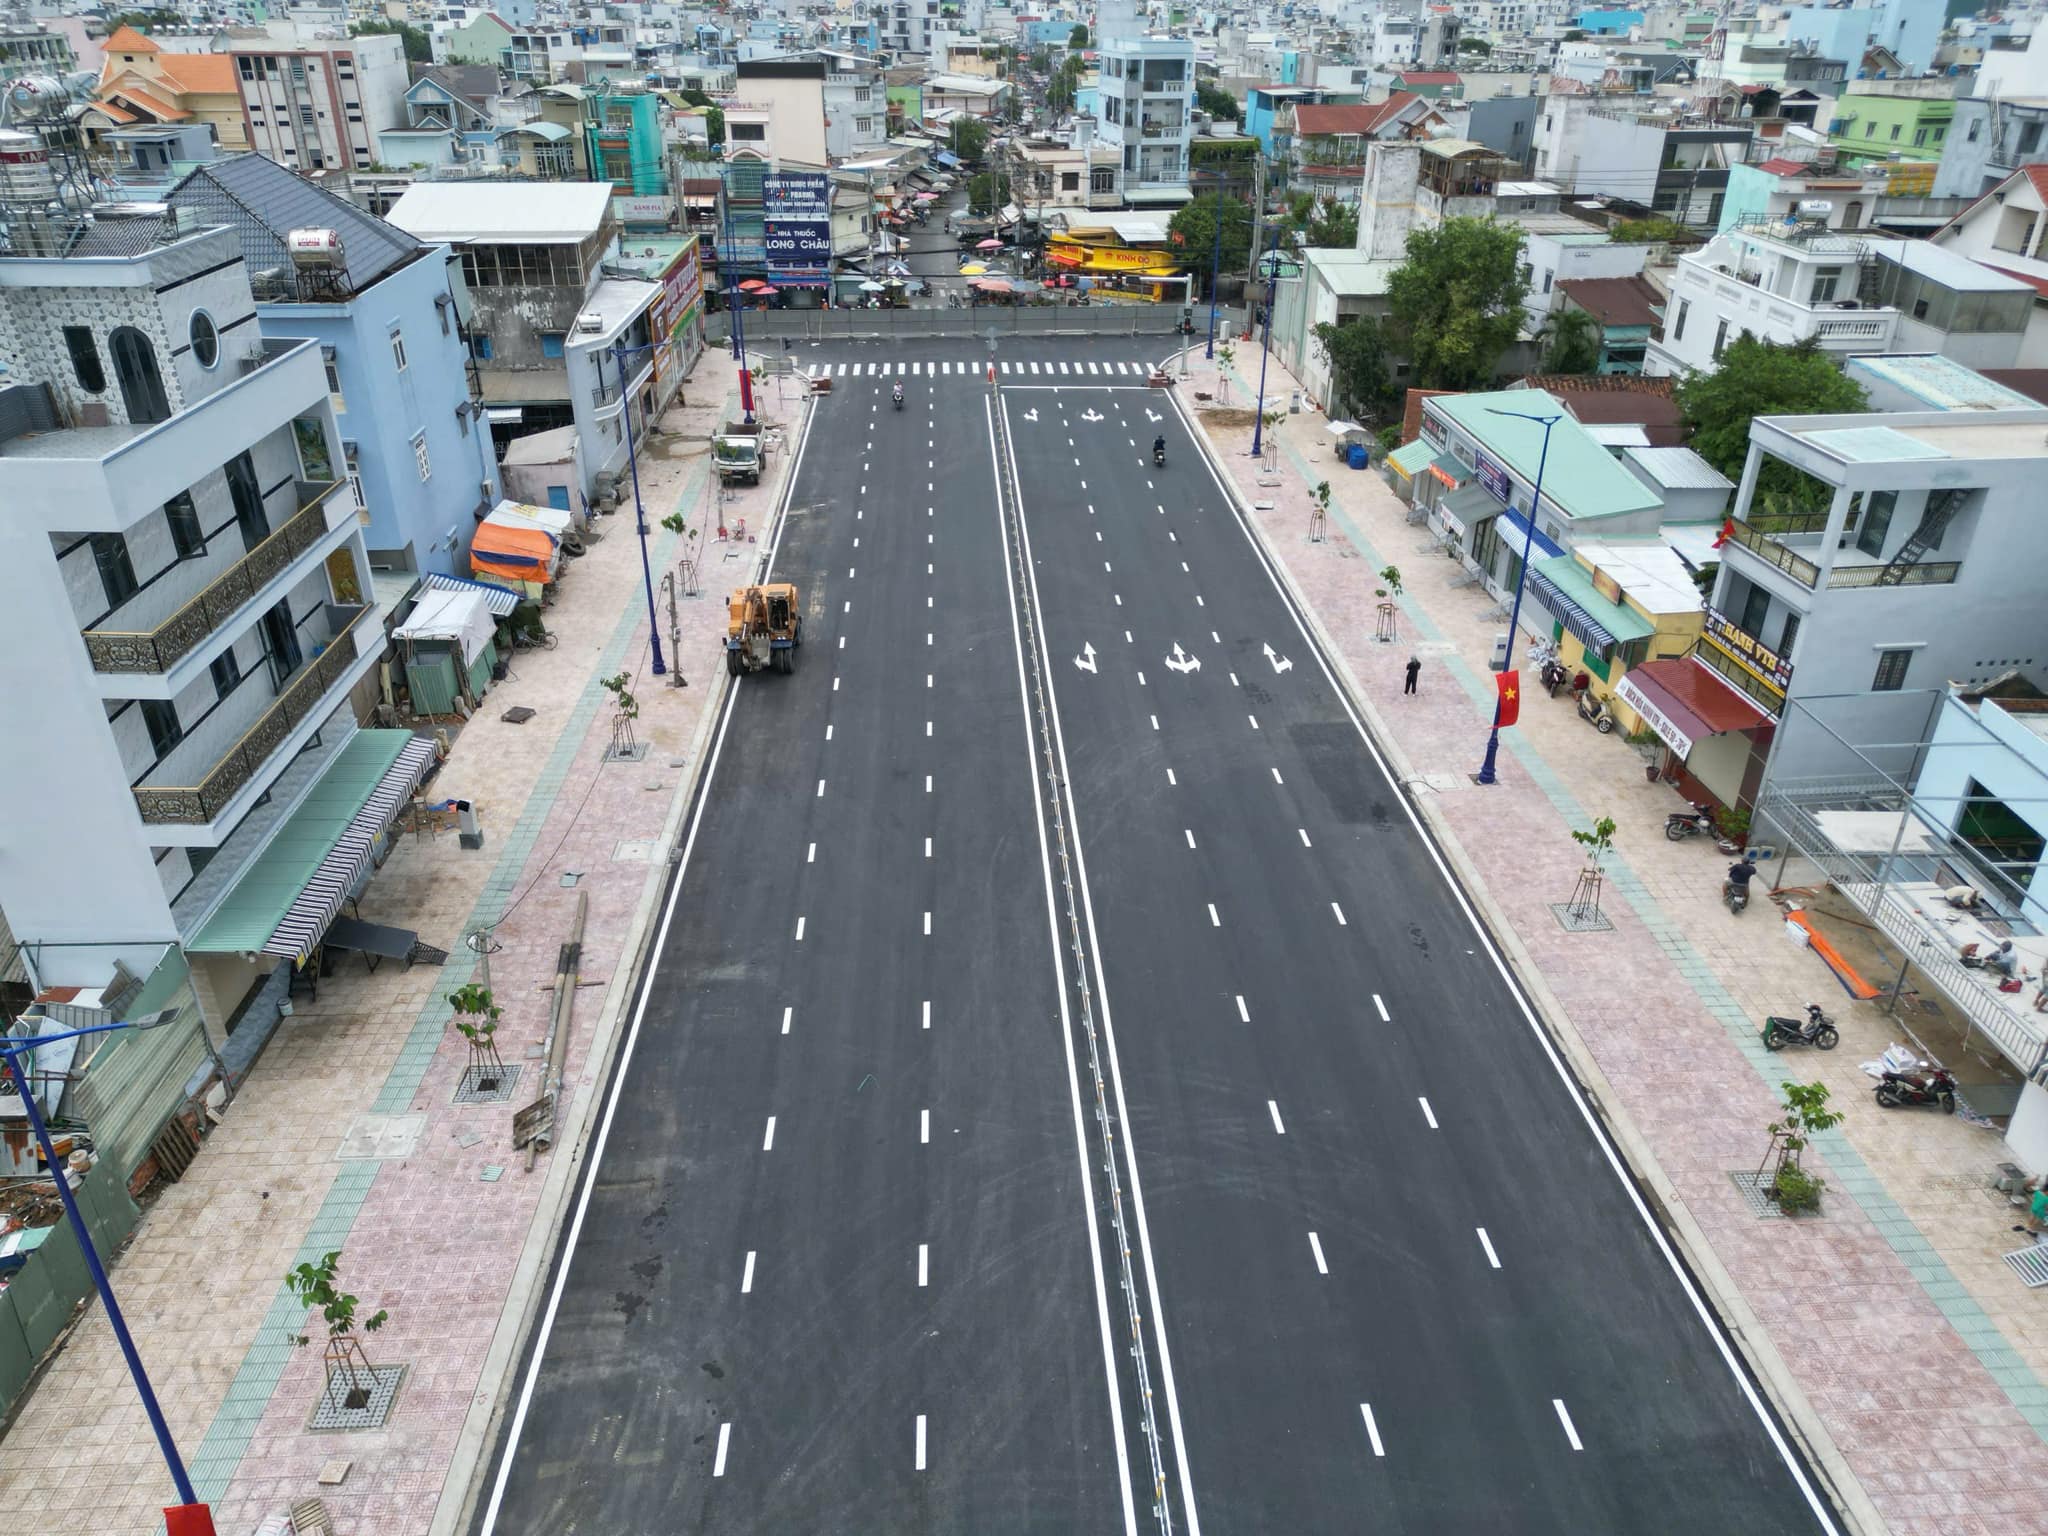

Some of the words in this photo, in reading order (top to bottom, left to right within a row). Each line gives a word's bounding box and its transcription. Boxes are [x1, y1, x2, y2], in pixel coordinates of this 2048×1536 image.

[794, 228, 816, 237] THUỐC
[766, 240, 796, 249] LONG
[800, 238, 830, 249] CHÂU
[1116, 254, 1136, 263] KINH
[1722, 622, 1756, 654] HẠNH
[1755, 644, 1779, 672] VTH
